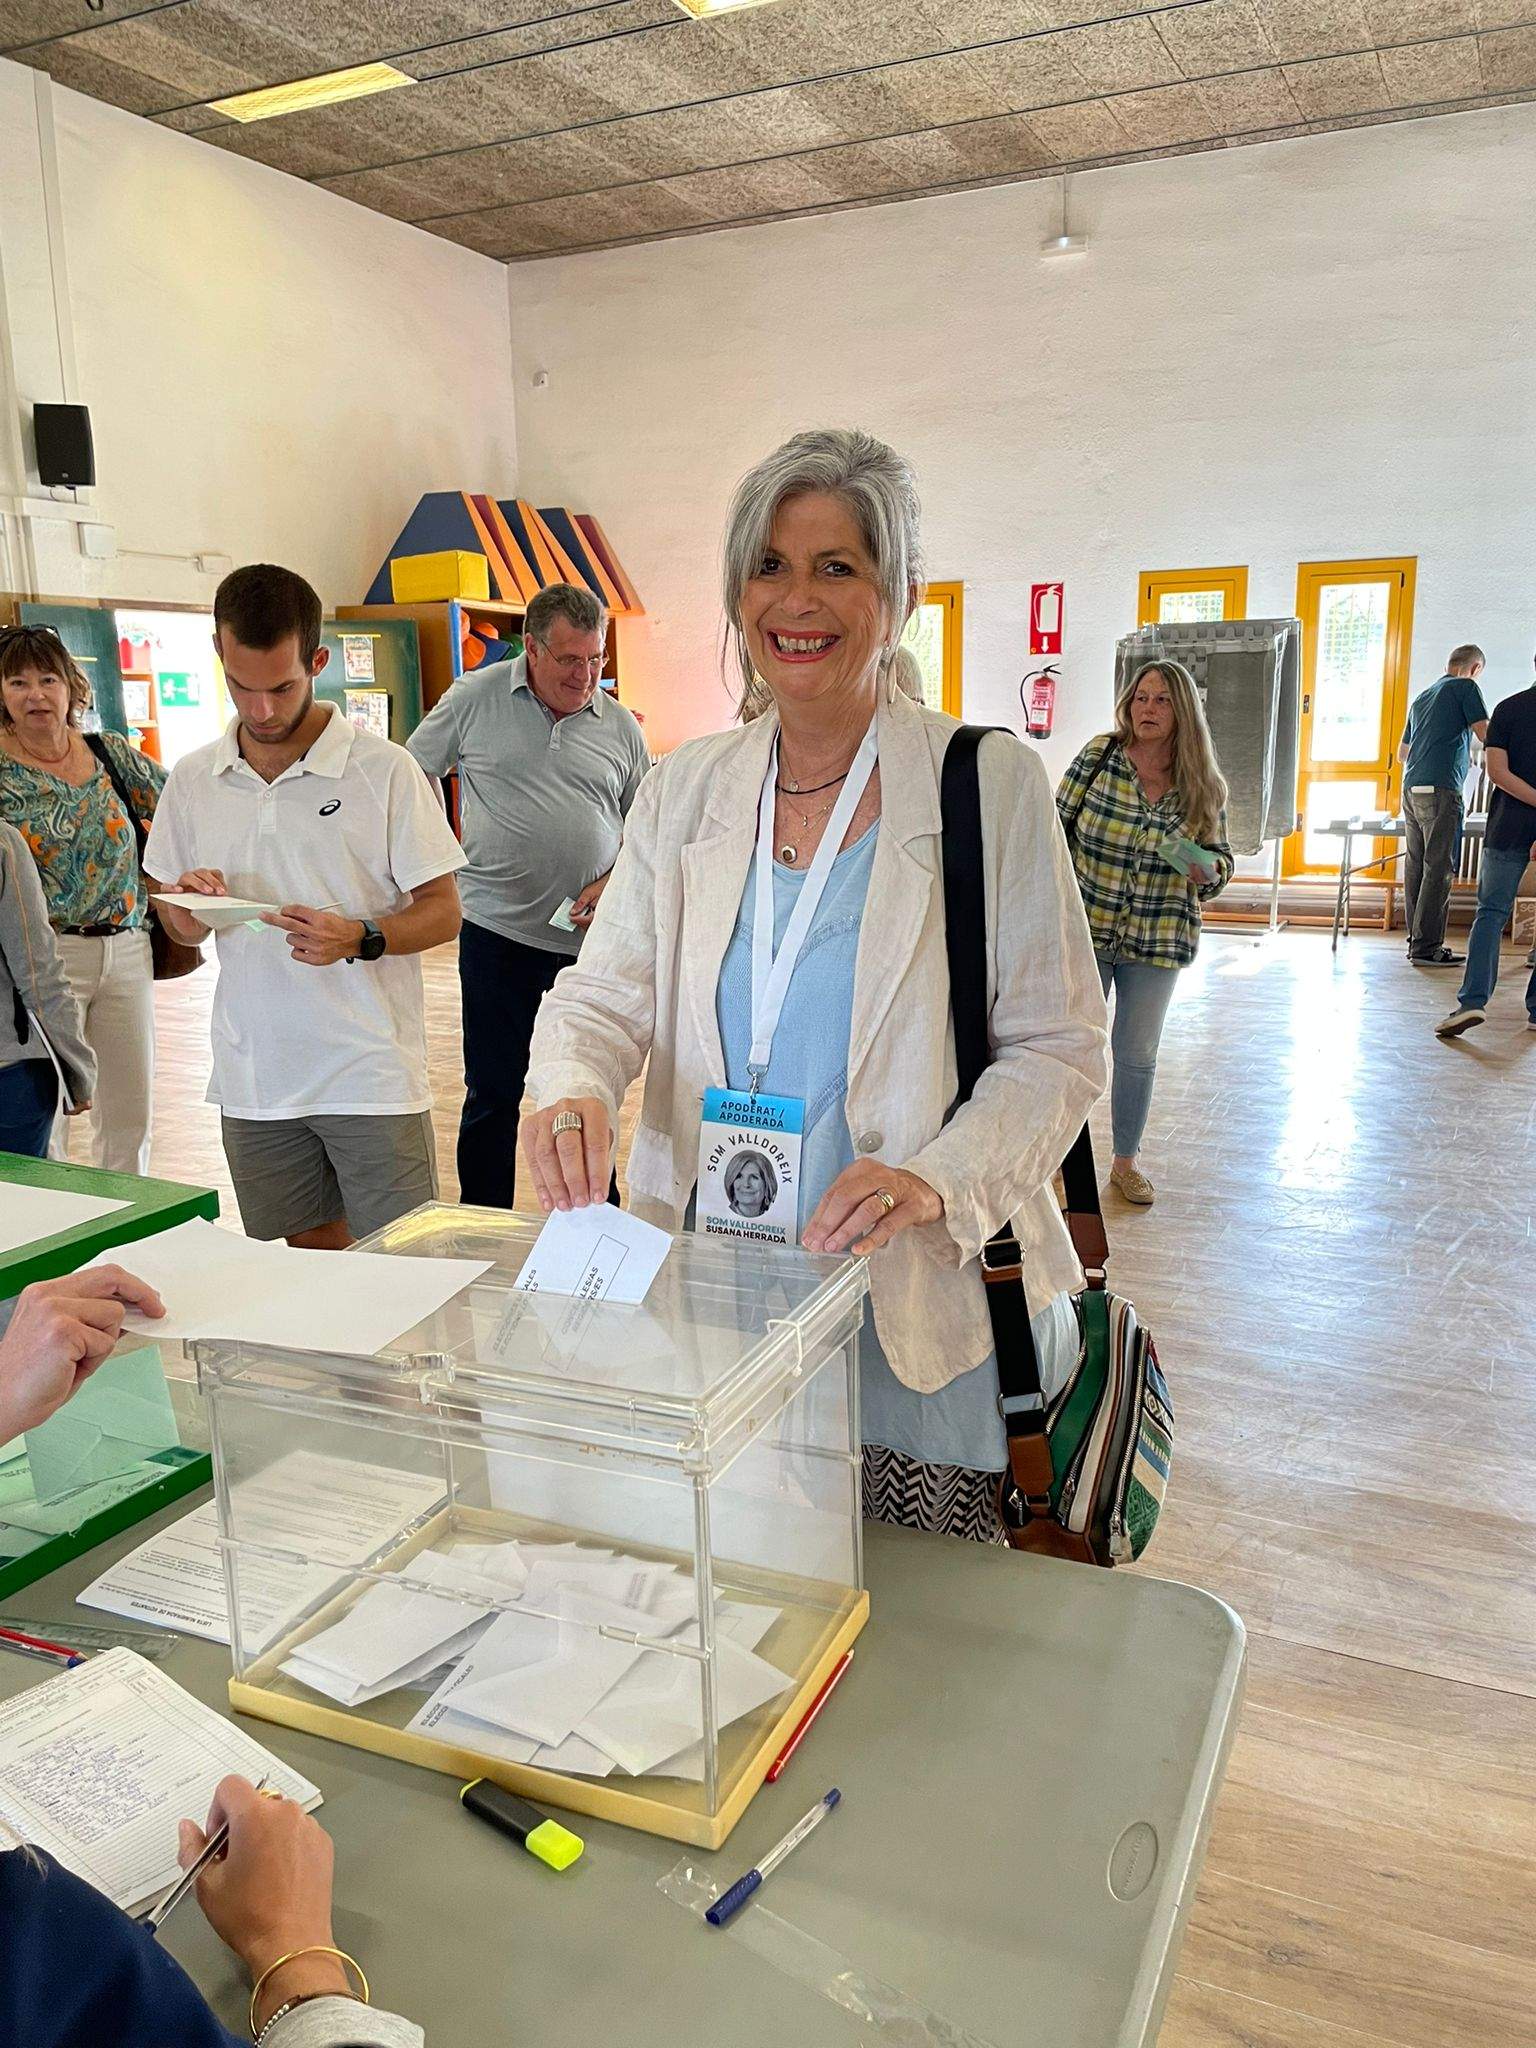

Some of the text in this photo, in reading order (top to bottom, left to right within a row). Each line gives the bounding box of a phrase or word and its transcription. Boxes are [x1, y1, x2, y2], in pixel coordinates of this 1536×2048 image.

[720, 1101, 776, 1116] APODERAT
[719, 1112, 784, 1128] APODERADA
[707, 1133, 793, 1184] SOM VALLDOREIX
[706, 1216, 786, 1235] SOM VALLDOREIX
[706, 1225, 787, 1244] SUSANA HERRADA
